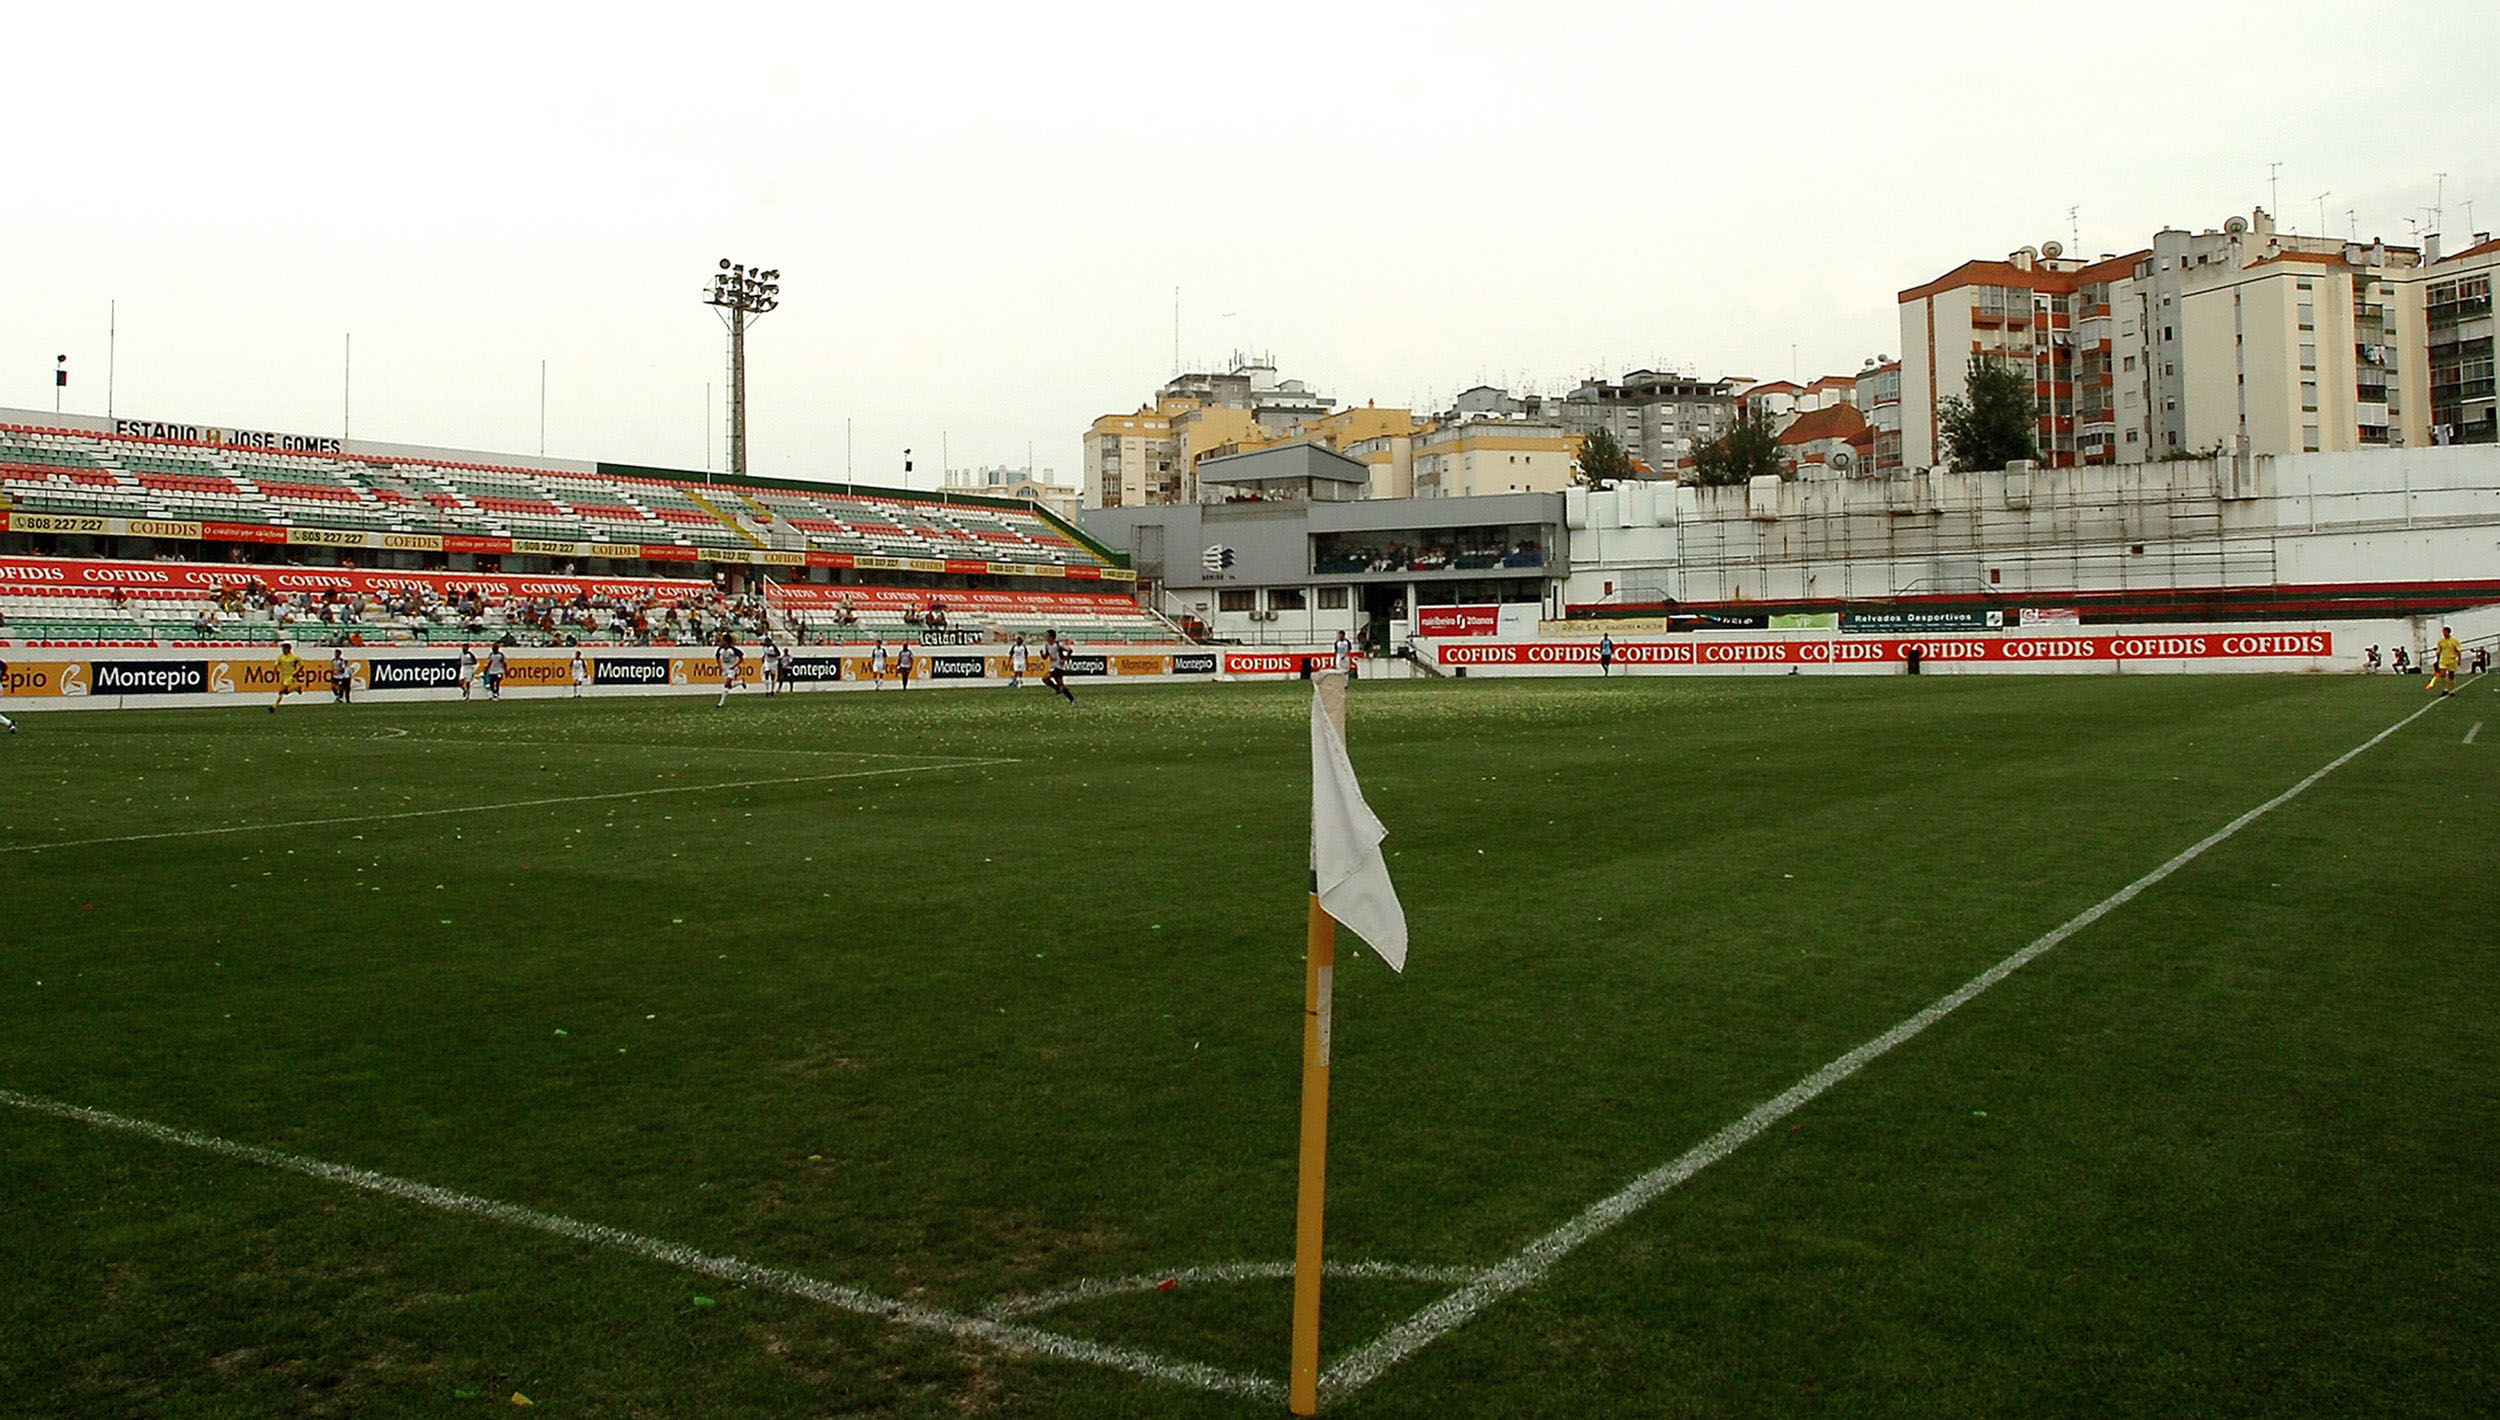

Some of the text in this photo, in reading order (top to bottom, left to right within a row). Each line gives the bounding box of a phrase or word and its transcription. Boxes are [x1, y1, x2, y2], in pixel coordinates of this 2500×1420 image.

[229, 431, 275, 449] JOSE
[282, 436, 341, 454] GOMES
[27, 518, 104, 531] 808 227 227
[130, 521, 197, 536] COFIDIS
[384, 535, 440, 548] COFIDIS
[592, 545, 638, 557] COFIDIS
[83, 568, 170, 583] COFIDIS
[279, 575, 353, 588] COFIDIS
[521, 583, 583, 595] COFIDIS
[1446, 635, 2324, 662] COFIDIS COFIDIS COFIDIS COFIDIS COFIDIS COFIDIS COFIDIS COFIDIS COFIDIS
[598, 661, 665, 682] Montepio
[693, 662, 754, 679] Monpio
[791, 660, 837, 678] ontepio
[933, 659, 982, 676] Montepio
[1064, 658, 1105, 674] Montepio
[1121, 659, 1159, 671] Montepio
[1175, 656, 1213, 671] Montepio
[1230, 657, 1292, 671] COFIDIS
[98, 665, 201, 692] Montepio
[244, 664, 334, 687] Moepio
[375, 663, 457, 685] Montepio
